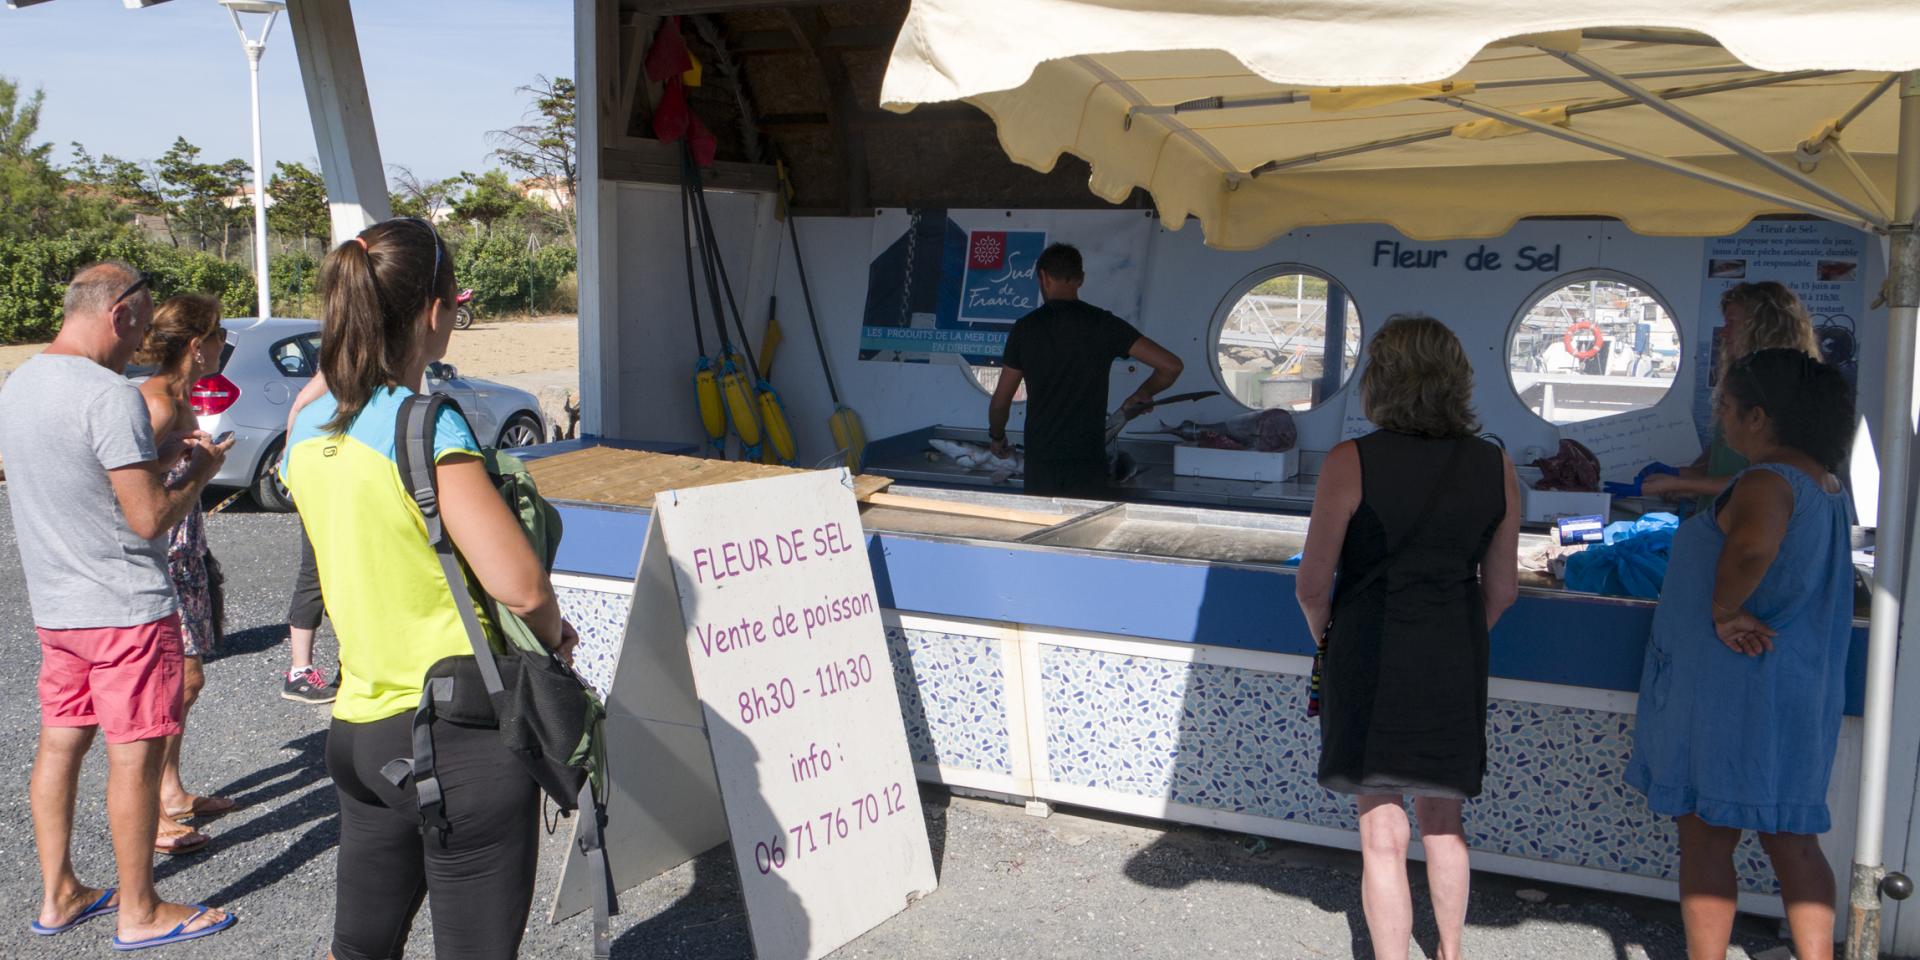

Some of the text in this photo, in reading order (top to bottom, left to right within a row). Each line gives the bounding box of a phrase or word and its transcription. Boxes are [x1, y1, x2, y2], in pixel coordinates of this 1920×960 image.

[991, 251, 1038, 283] Sud
[1373, 240, 1560, 272] Fleur de Sel
[1826, 248, 1858, 257] durable
[968, 287, 1034, 308] France
[998, 283, 1016, 296] de
[867, 328, 882, 337] LES
[887, 328, 933, 340] PRODUITS
[935, 330, 948, 340] DE
[950, 331, 962, 341] LA
[964, 332, 985, 342] MER
[987, 332, 1002, 343] DU
[932, 342, 1003, 354] EN DIRECT DES
[694, 522, 852, 584] FLEUR DE SEL
[696, 590, 874, 658] Vente de poisson
[738, 677, 795, 724] 8h30
[815, 654, 873, 697] 11h30
[790, 744, 832, 783] info
[754, 782, 906, 875] 06 71 76 70 12
